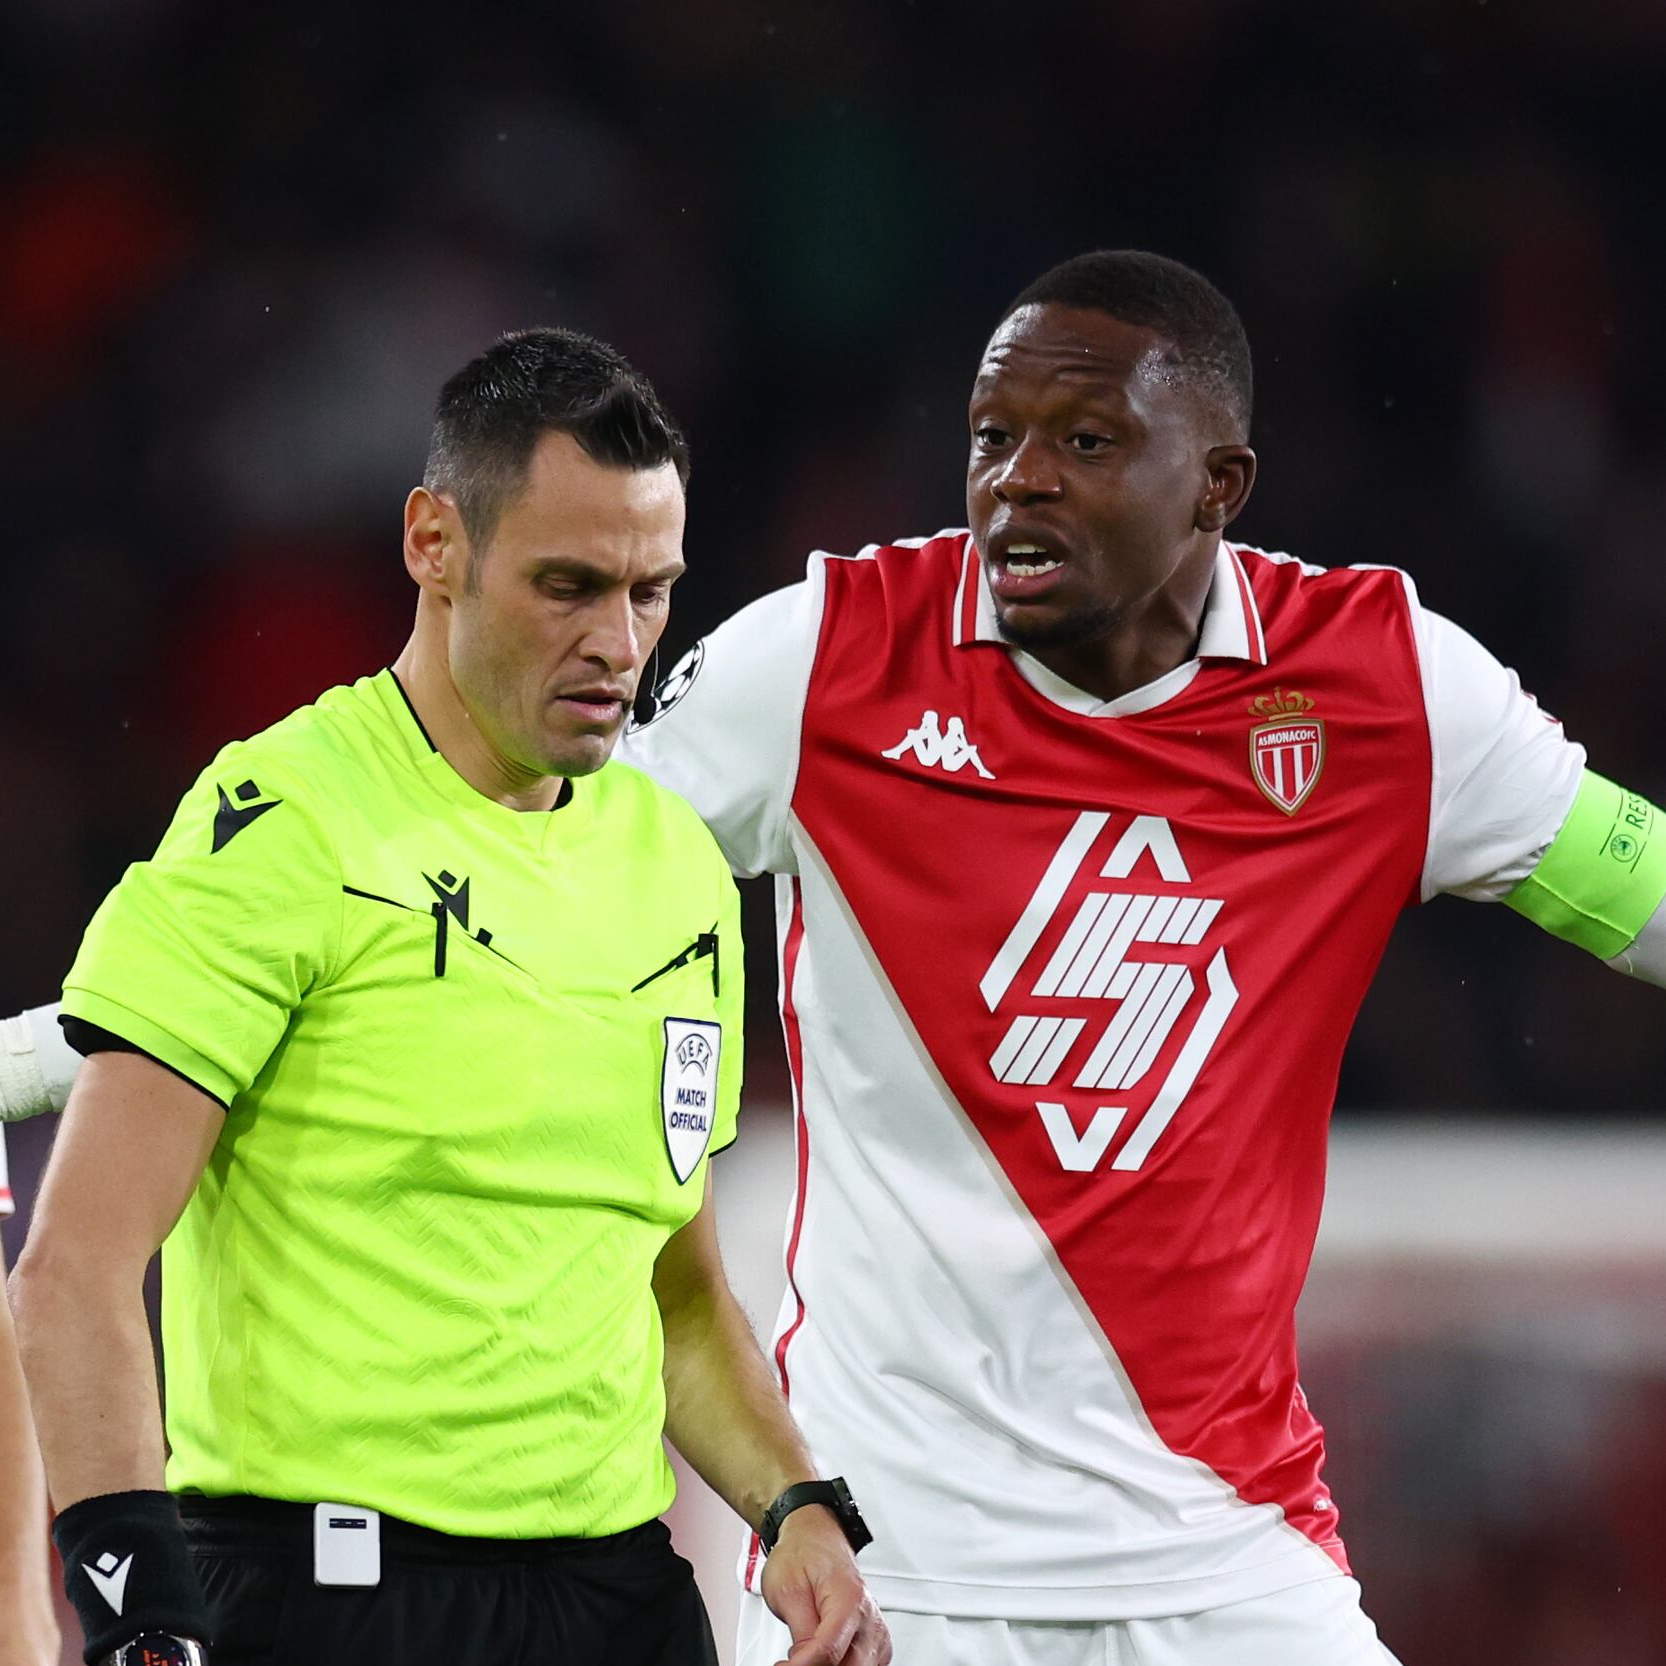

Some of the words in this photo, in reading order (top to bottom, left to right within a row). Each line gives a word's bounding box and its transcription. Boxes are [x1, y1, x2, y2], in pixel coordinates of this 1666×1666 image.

[677, 1039, 710, 1071] UEFA
[676, 1087, 707, 1107] MATCH
[670, 1112, 707, 1131] OFFICIAL
